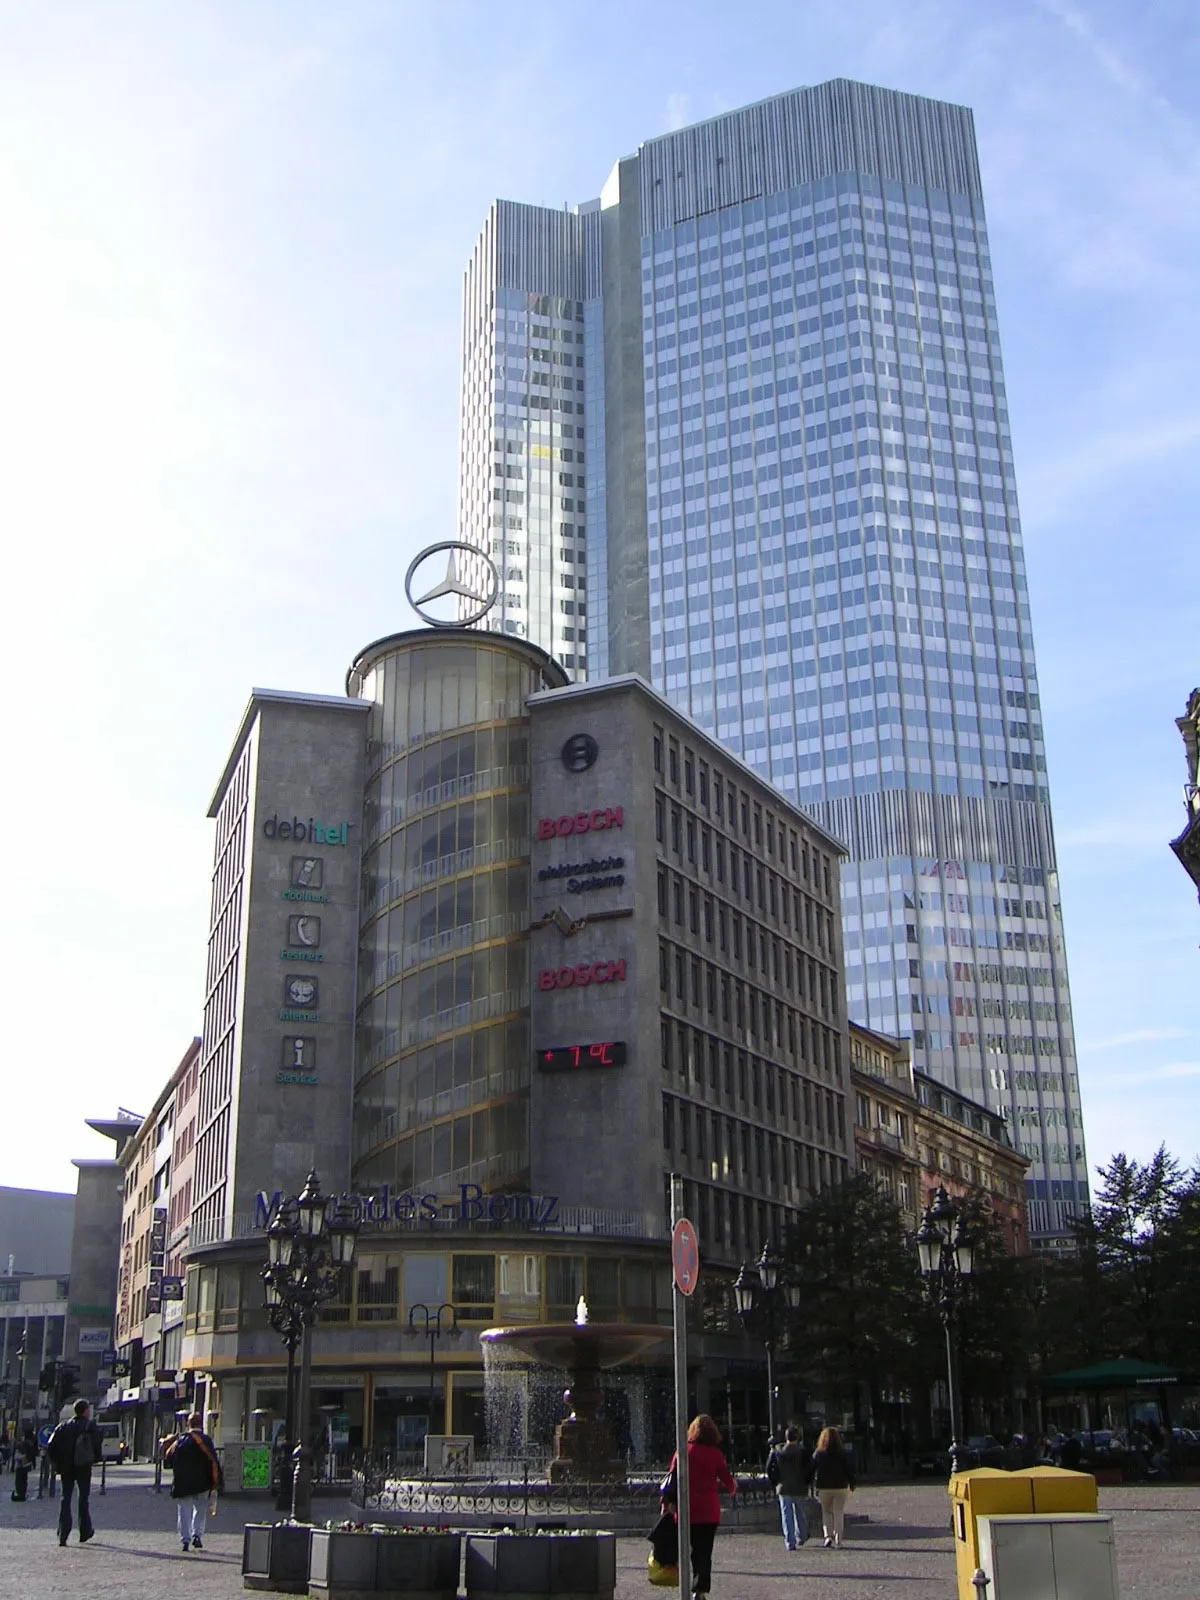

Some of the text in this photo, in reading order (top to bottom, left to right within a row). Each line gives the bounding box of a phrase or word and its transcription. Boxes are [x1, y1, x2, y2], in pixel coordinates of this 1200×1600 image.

[263, 814, 348, 847] debitel
[537, 806, 624, 841] BOSCH
[537, 959, 626, 992] BOSCH
[253, 1183, 560, 1229] Mcdes-Benz
